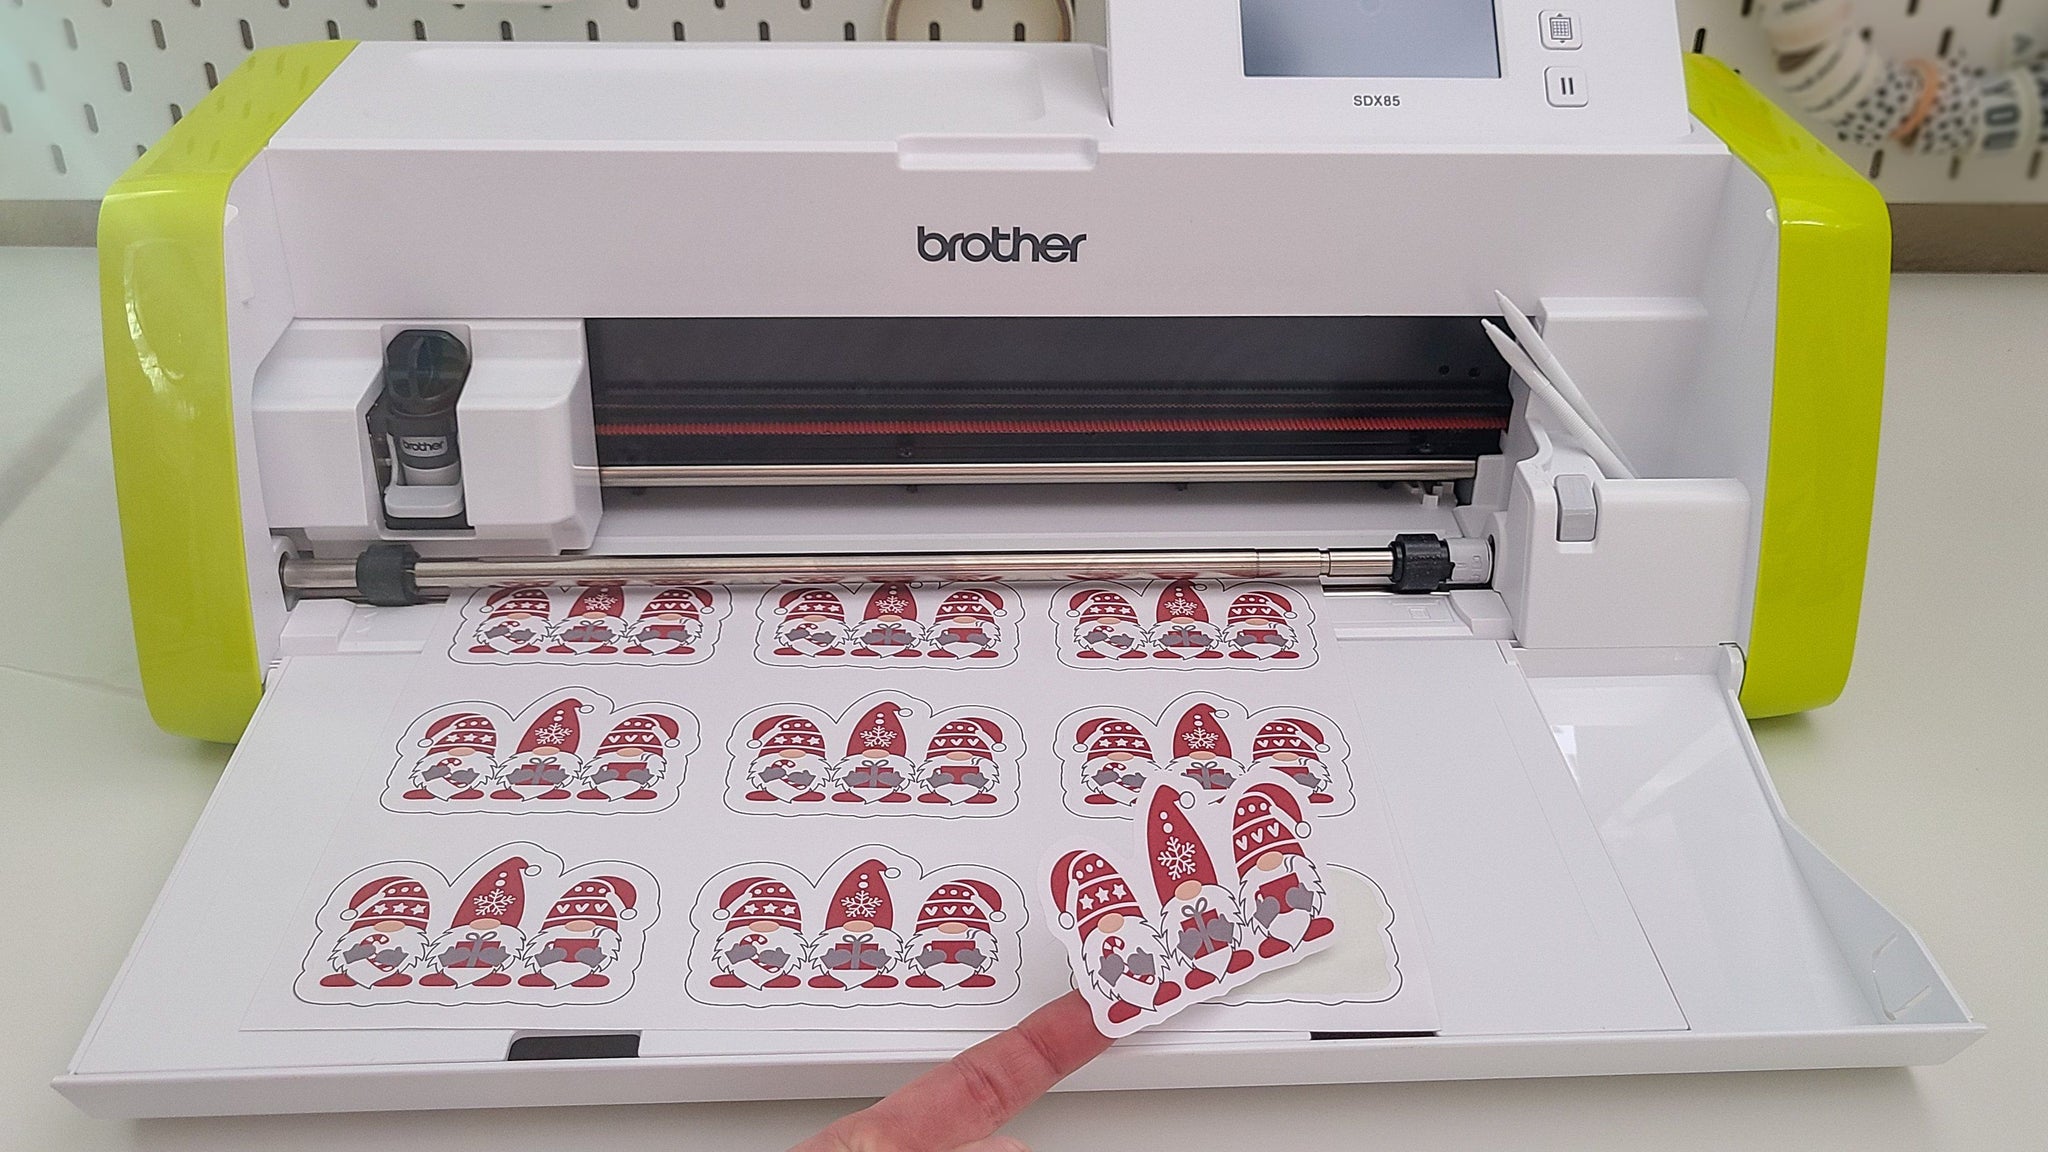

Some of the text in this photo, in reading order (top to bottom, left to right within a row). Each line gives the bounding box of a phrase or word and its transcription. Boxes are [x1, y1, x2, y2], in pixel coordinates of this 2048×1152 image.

[1353, 95, 1401, 107] SDX85
[917, 226, 1087, 262] brother
[402, 439, 445, 452] brother
